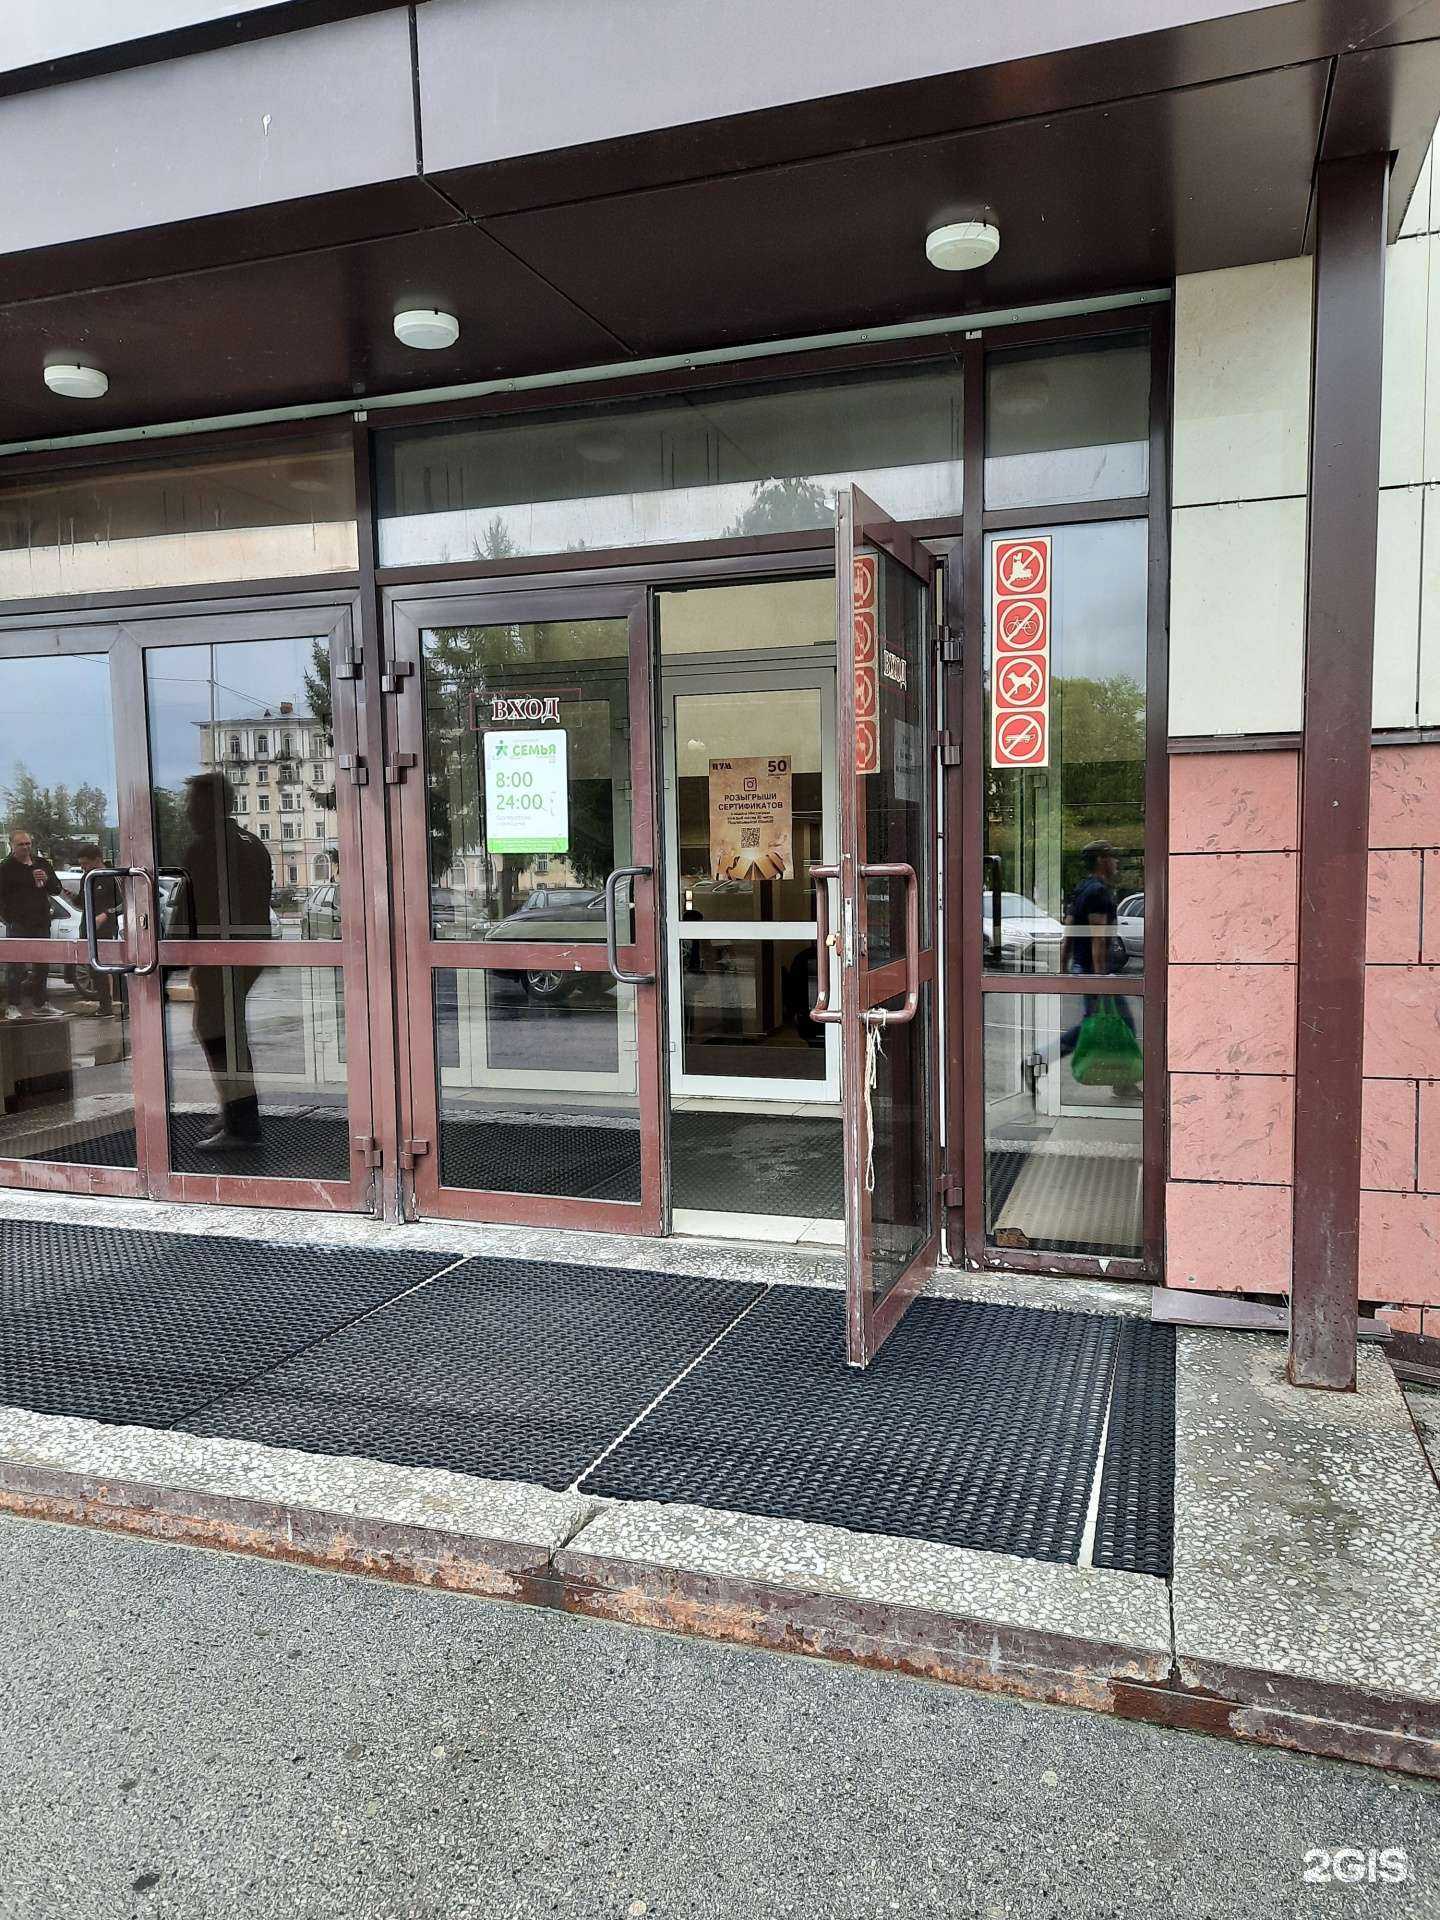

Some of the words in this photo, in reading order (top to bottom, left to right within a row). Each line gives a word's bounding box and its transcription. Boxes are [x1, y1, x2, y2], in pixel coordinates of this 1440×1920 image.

[883, 649, 907, 691] ВХОД
[492, 697, 561, 724] ВХОД
[512, 743, 557, 756] СЕМЬЯ
[768, 760, 787, 772] 50
[495, 771, 533, 788] 8:00
[495, 794, 543, 810] 24:00
[724, 793, 777, 802] РОЗЫГРЫШИ
[718, 802, 783, 811] СЕРТИФИКАТОВ
